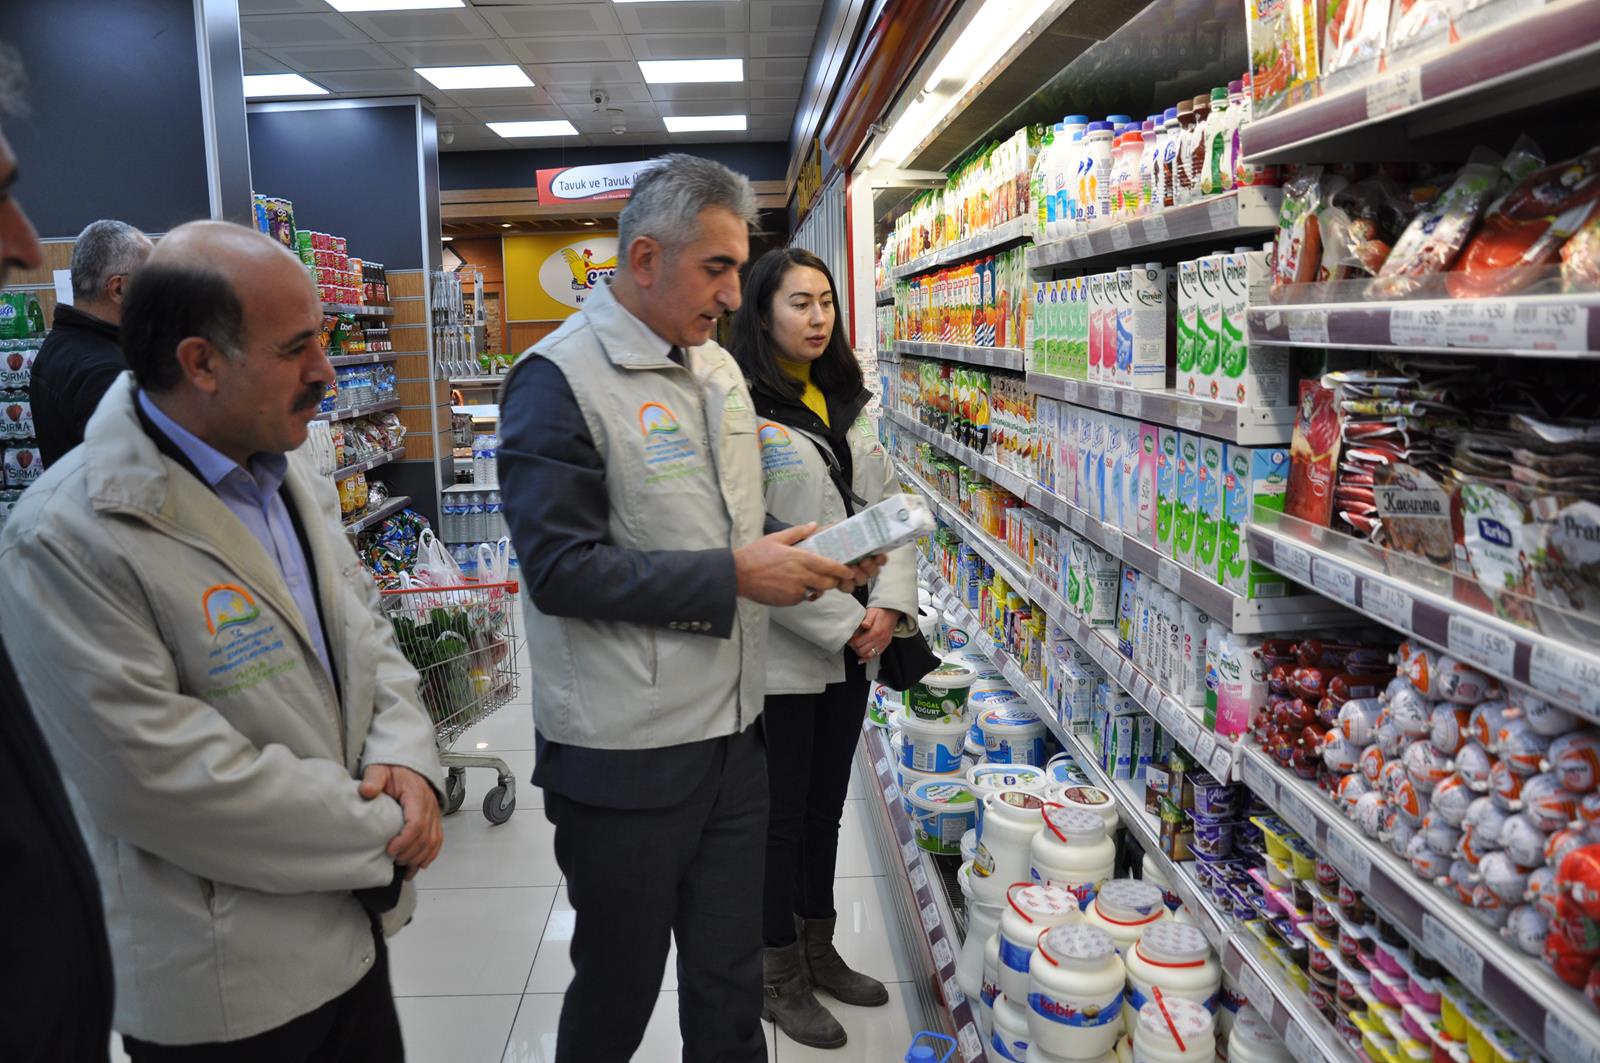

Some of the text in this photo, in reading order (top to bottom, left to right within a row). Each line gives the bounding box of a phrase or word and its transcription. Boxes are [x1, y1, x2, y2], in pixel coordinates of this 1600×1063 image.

[559, 179, 587, 191] Tavuk
[589, 180, 601, 188] ve
[603, 175, 631, 187] Tavuk
[0, 370, 30, 382] SIRMA
[0, 421, 31, 433] SIRMA
[9, 468, 40, 479] SIRMA
[1039, 993, 1077, 1018] kebir
